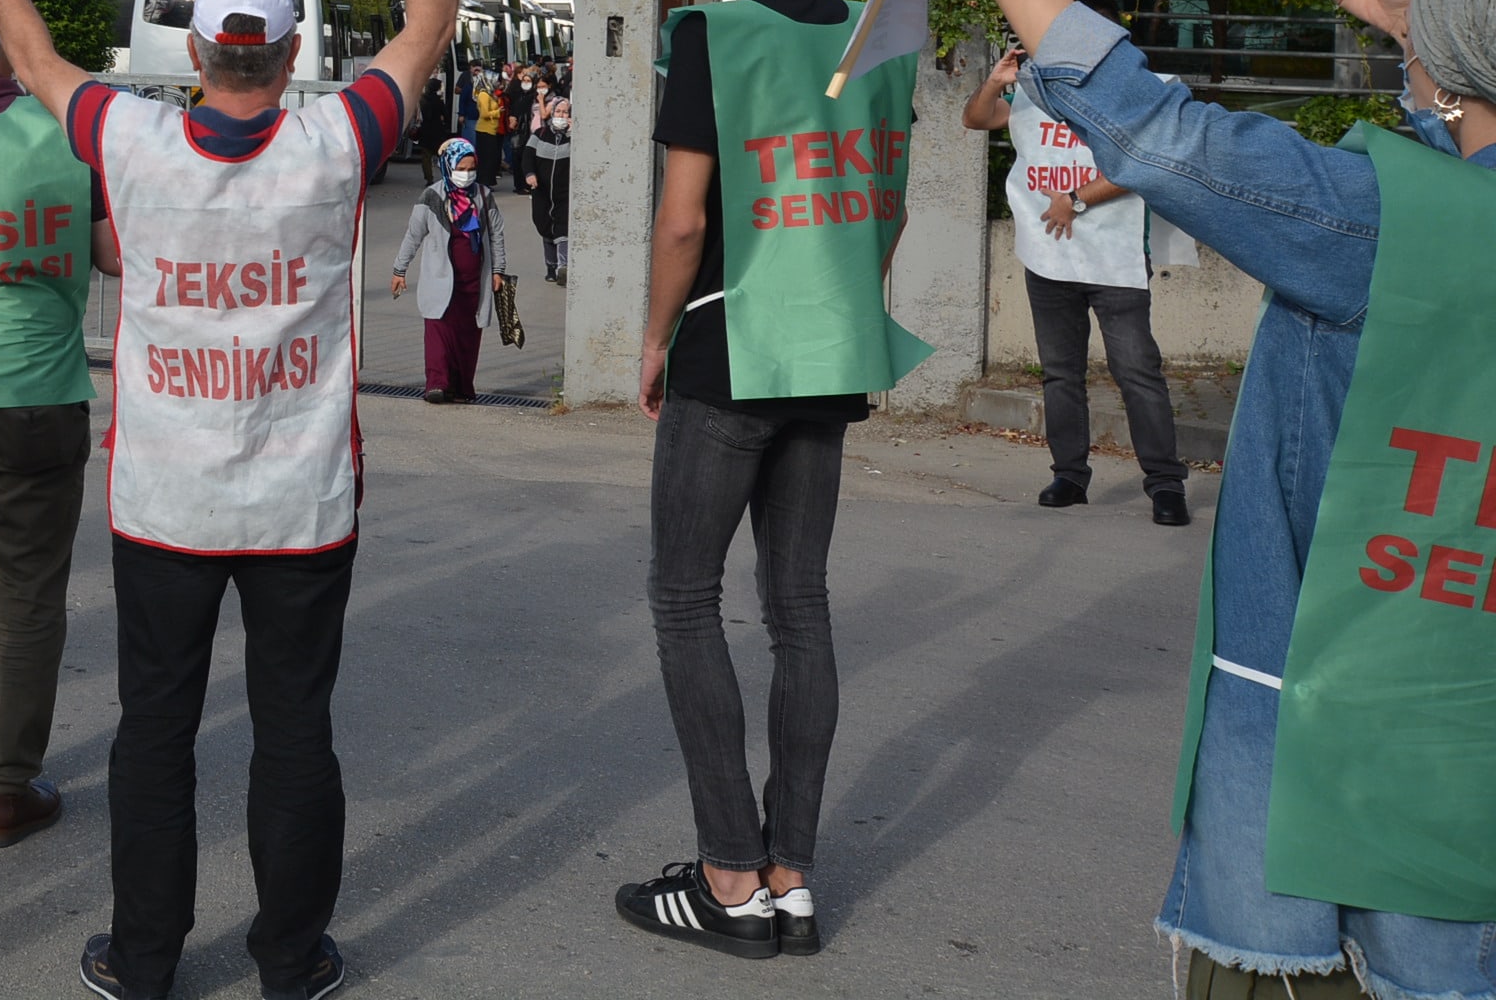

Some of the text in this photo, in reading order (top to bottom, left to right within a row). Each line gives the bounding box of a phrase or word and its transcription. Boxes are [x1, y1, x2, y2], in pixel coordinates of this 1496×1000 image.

[155, 249, 308, 310] TEKSİF
[147, 335, 318, 402] SENDİKASI
[1388, 426, 1496, 530] T
[1358, 534, 1496, 614] SE
